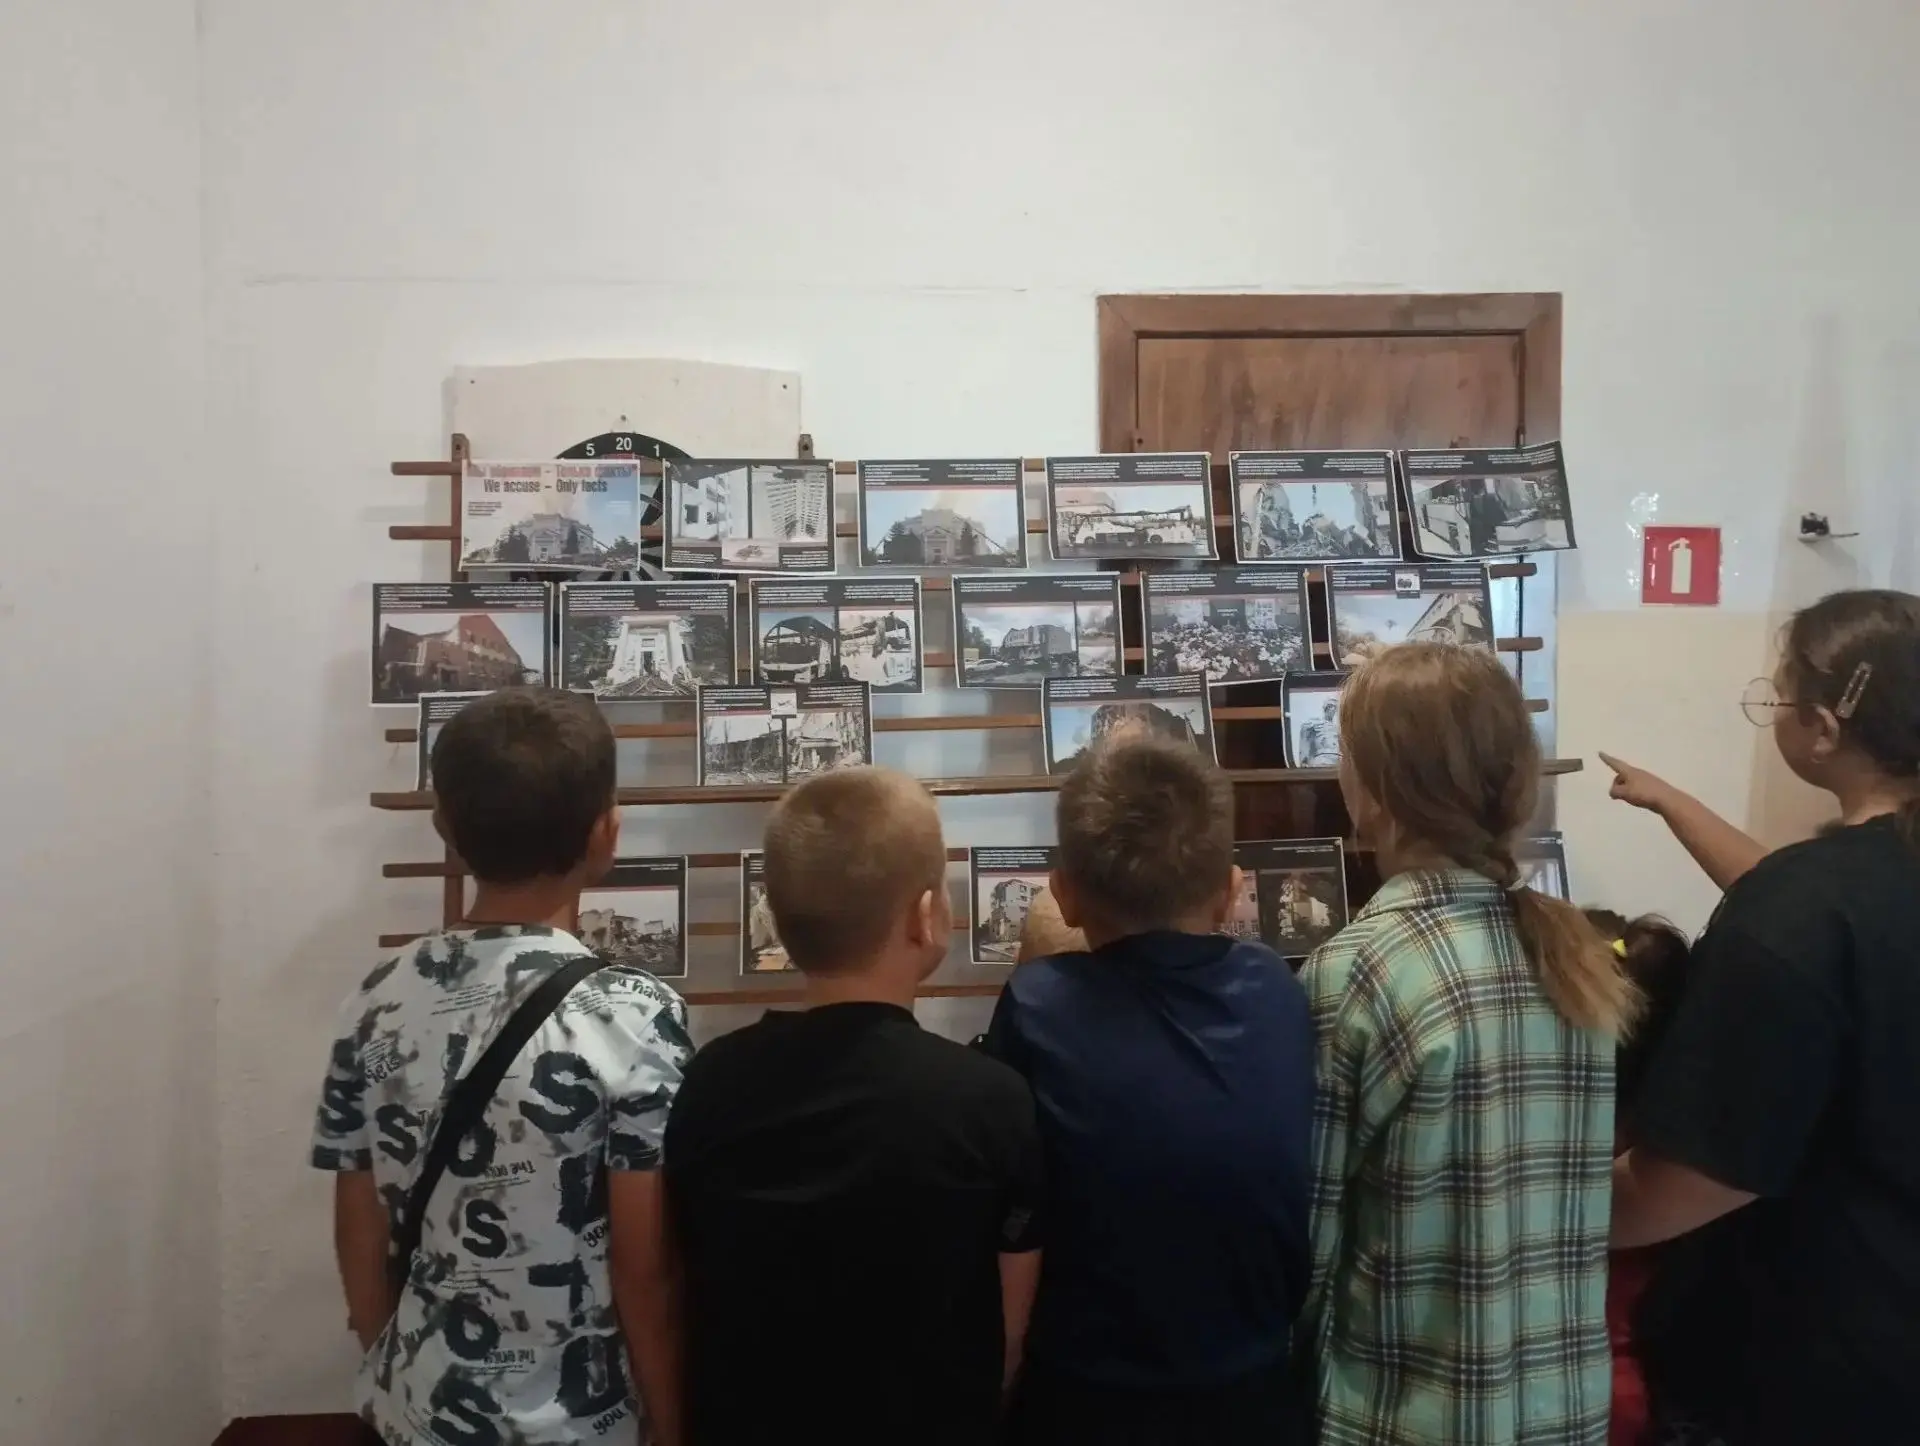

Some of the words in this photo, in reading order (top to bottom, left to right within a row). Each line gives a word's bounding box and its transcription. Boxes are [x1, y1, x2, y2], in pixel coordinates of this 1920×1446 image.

[585, 443, 596, 458] 5
[615, 436, 633, 451] 20
[652, 444, 661, 458] 1
[483, 479, 502, 493] We
[503, 480, 541, 493] accuse
[555, 479, 578, 495] Only
[461, 1198, 510, 1259] S
